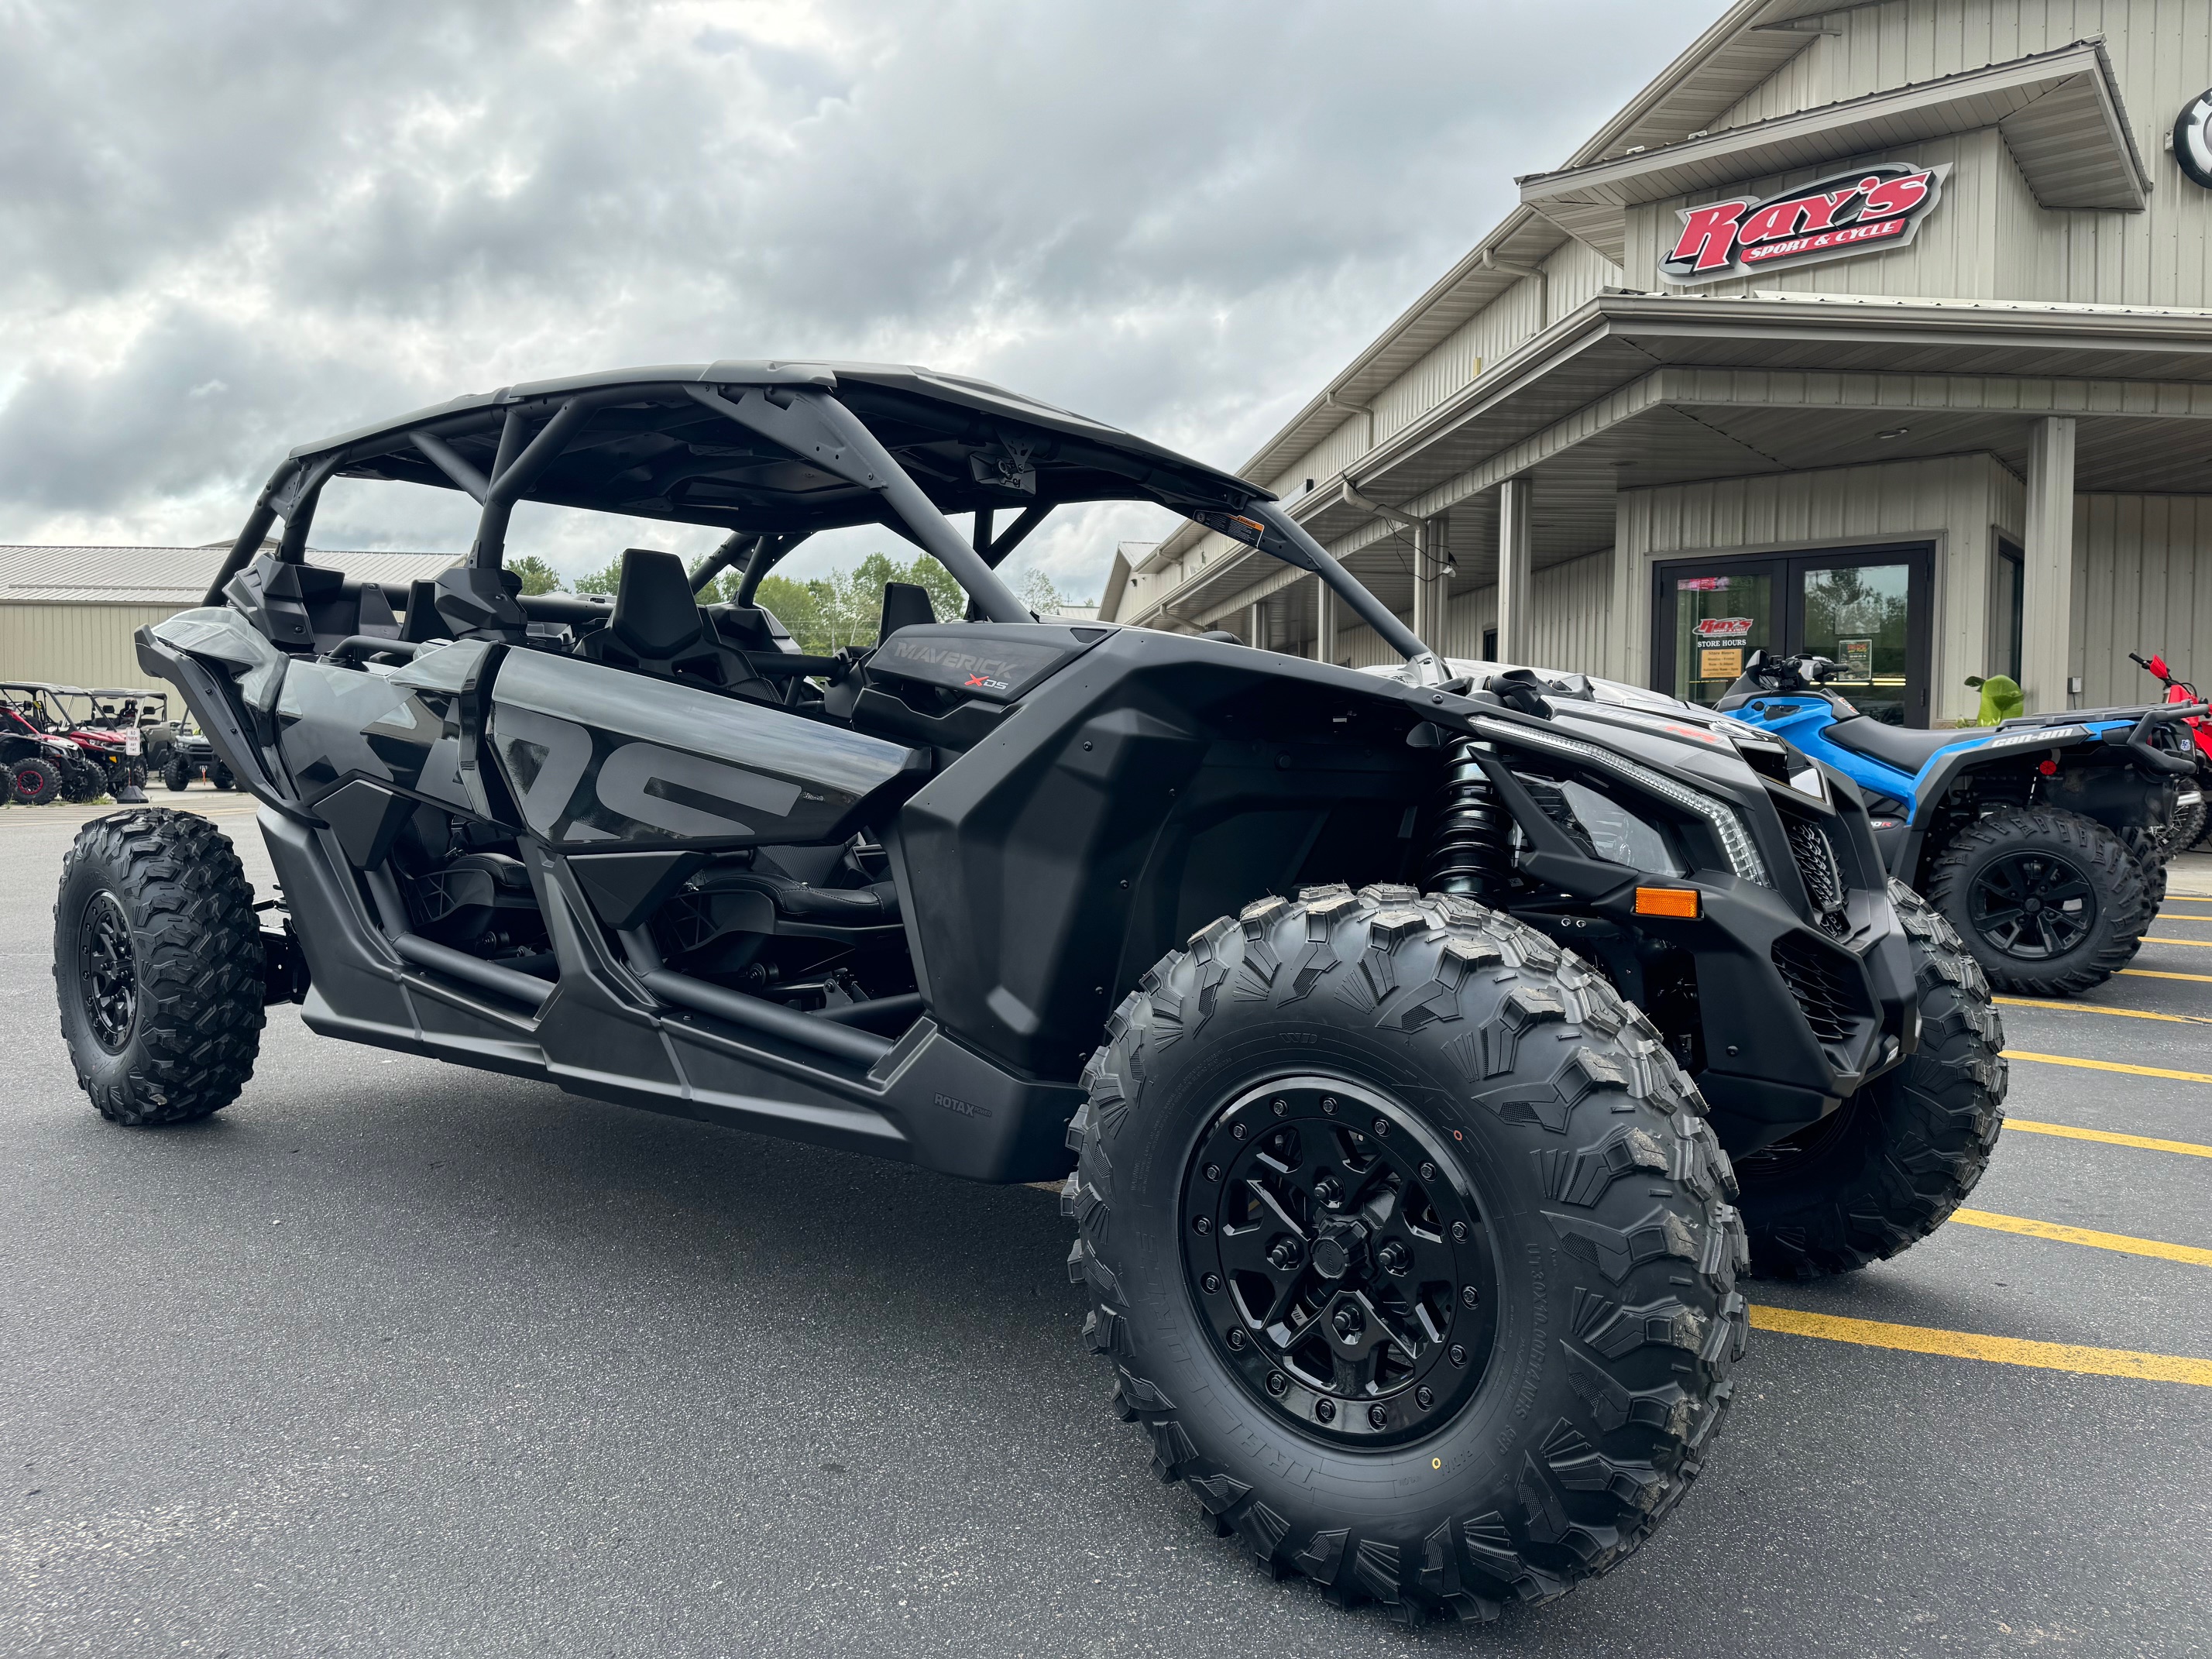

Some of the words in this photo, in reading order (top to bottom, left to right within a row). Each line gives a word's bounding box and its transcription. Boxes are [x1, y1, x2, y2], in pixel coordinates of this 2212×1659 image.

[1748, 237, 1809, 260] SPORT
[1814, 234, 1830, 247] &
[1835, 221, 1895, 242] CYCLE
[894, 642, 1019, 678] MAVERICK
[1991, 728, 2073, 748] can-am
[934, 1092, 974, 1117] ROTAX
[974, 1106, 992, 1118] POWER
